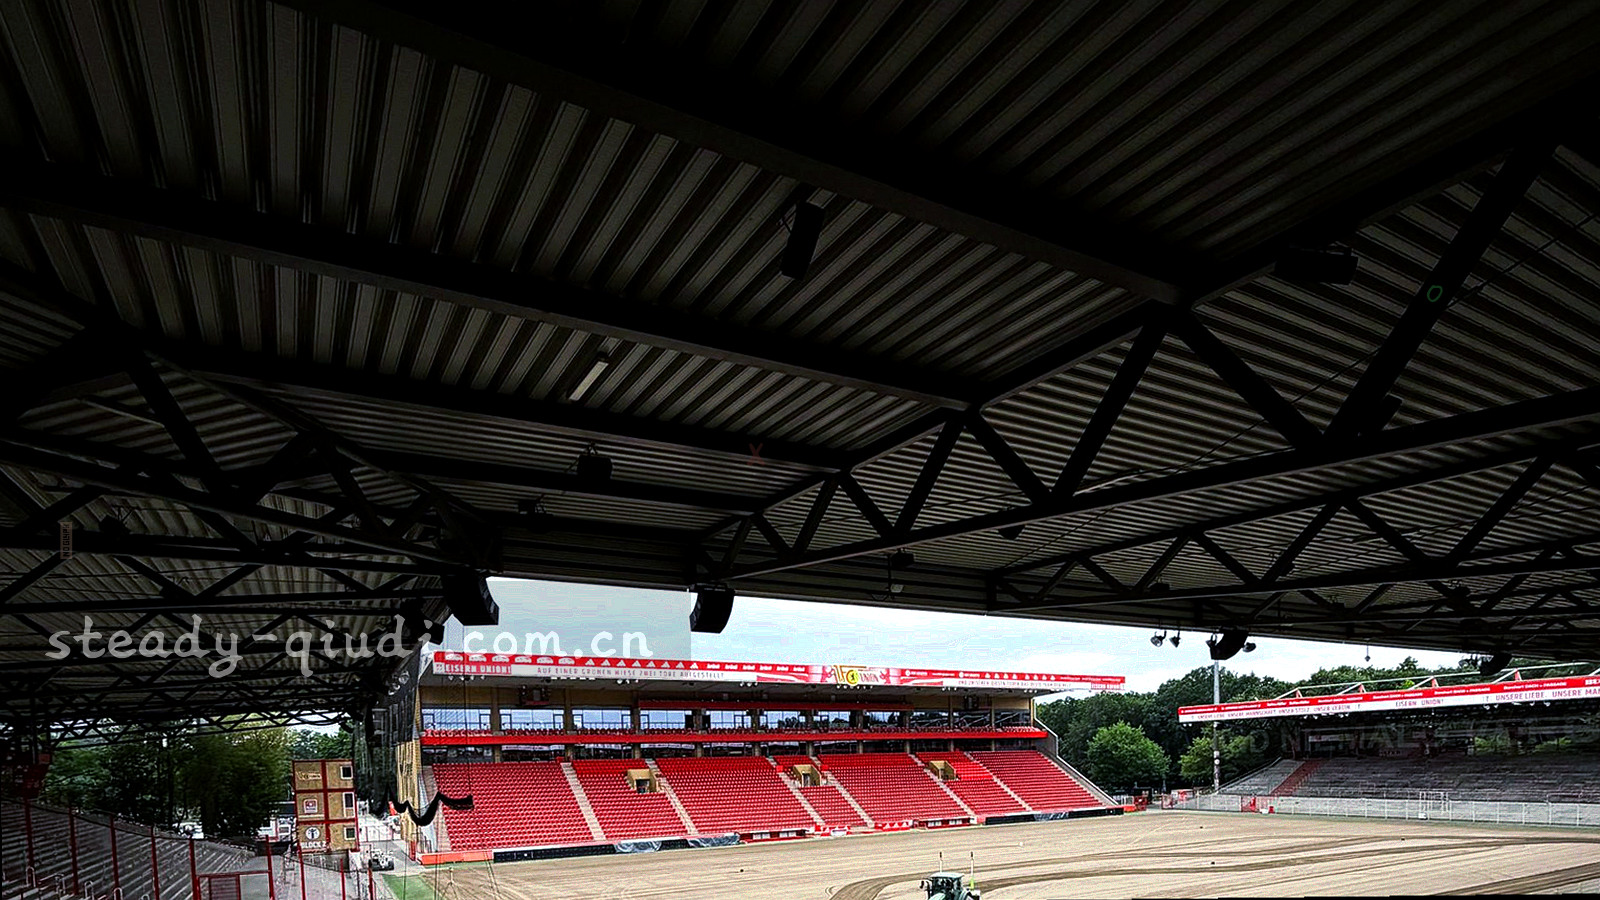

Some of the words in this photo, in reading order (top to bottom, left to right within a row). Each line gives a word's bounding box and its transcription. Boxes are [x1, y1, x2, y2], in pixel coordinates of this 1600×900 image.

[445, 664, 478, 674] EISERN
[480, 666, 512, 675] UNION!
[1496, 693, 1523, 701] UNSERE
[1552, 689, 1582, 698] UNSERE
